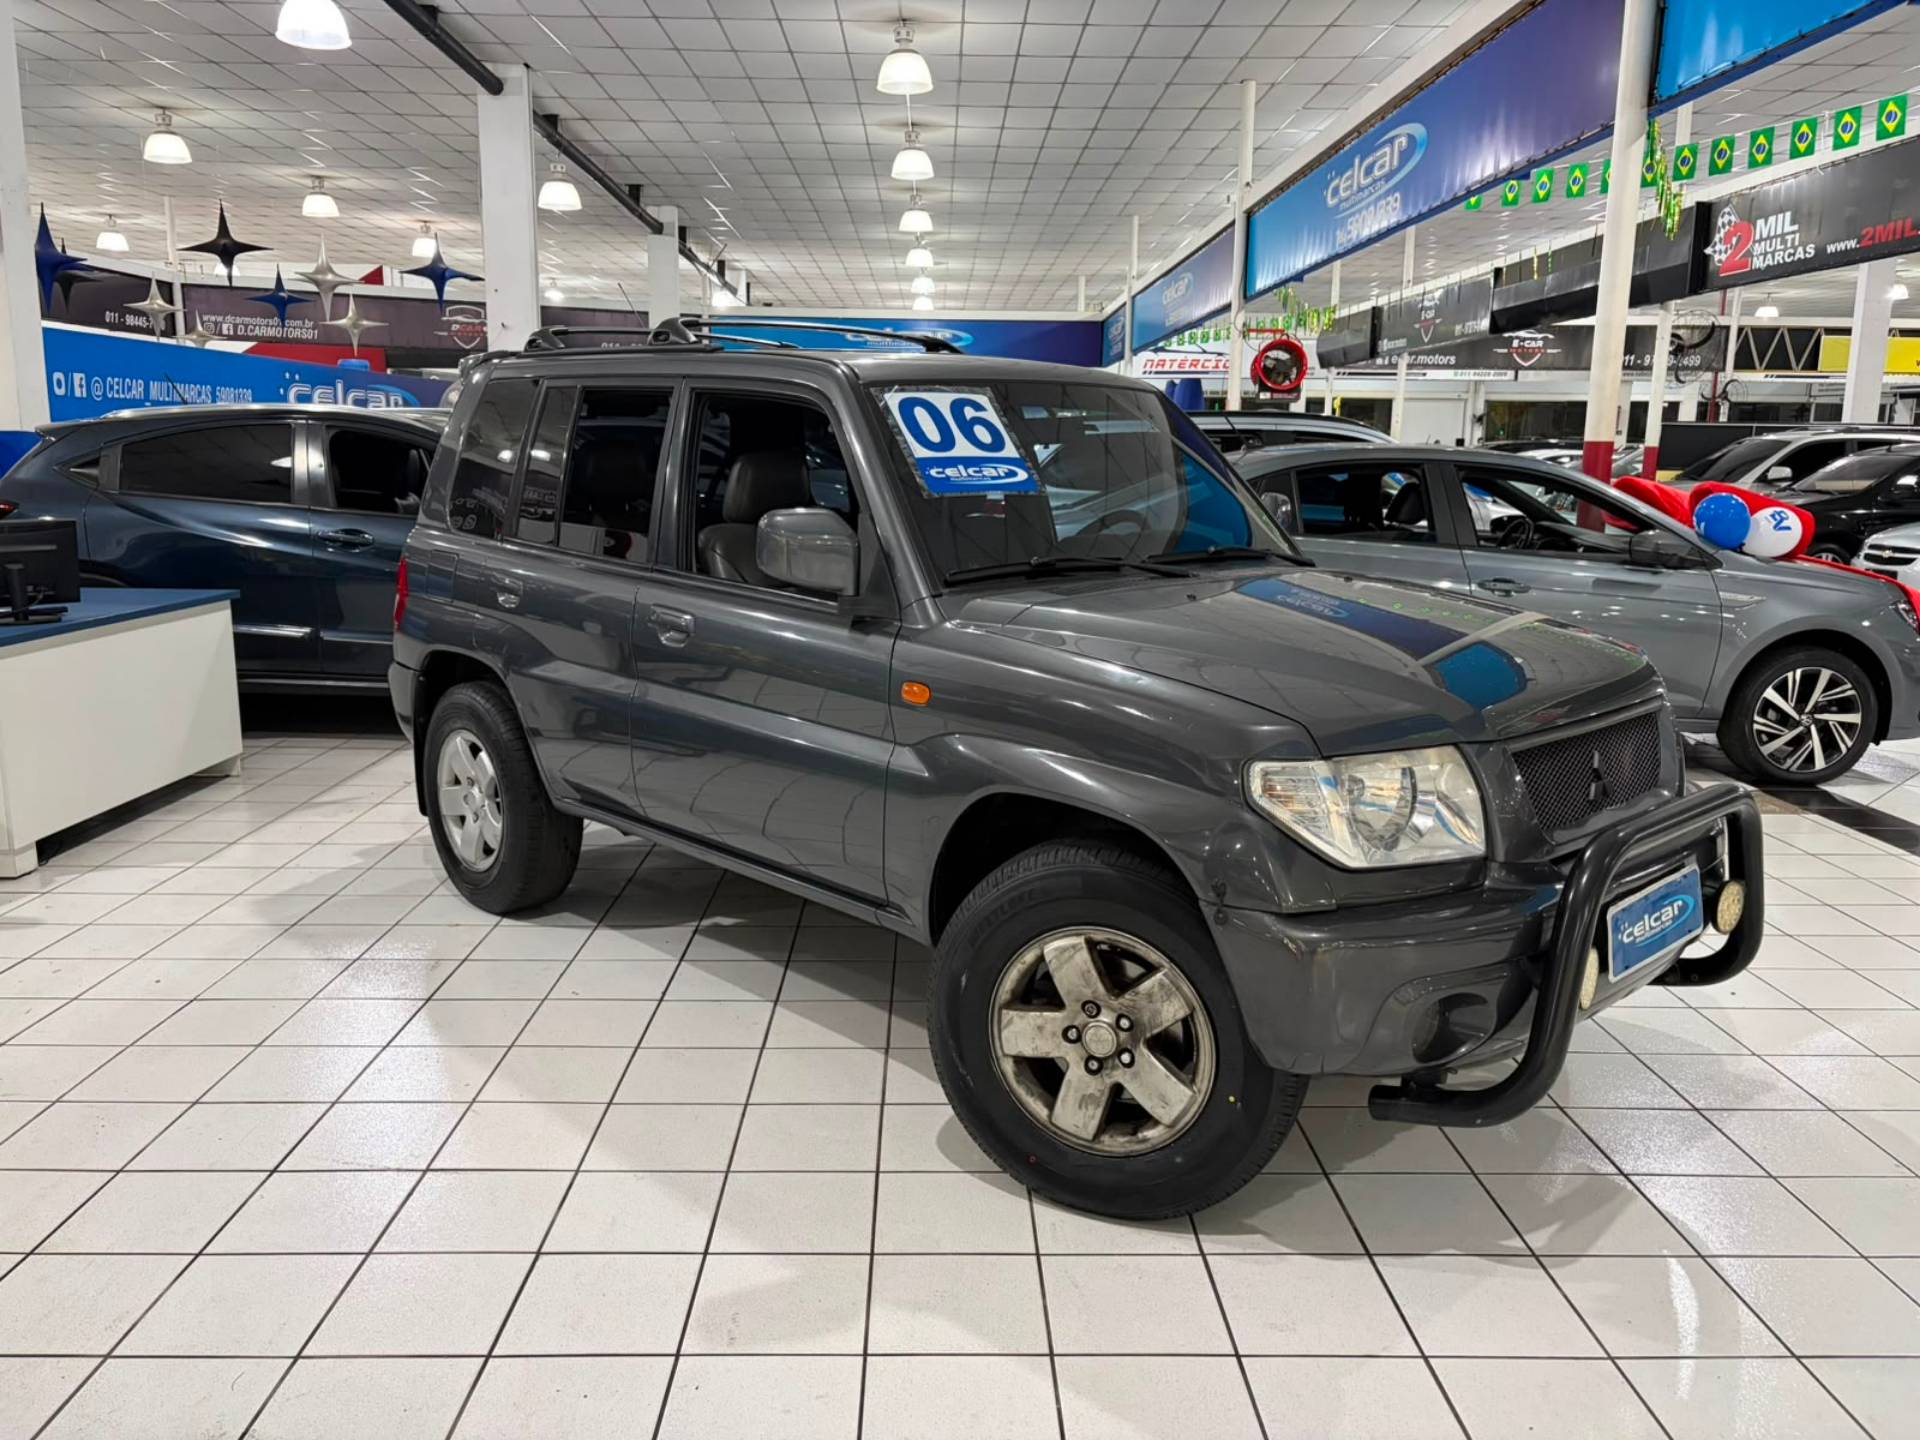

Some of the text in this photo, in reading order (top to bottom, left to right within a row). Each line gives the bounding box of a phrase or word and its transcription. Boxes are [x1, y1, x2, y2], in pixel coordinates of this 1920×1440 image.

[1326, 134, 1408, 208] celcar
[1719, 211, 1800, 276] 2 MIL
[1752, 232, 1800, 255] MULTI
[1752, 244, 1816, 270] MARCAS
[1512, 339, 1544, 348] E-CAR
[897, 396, 1006, 453] 06
[929, 464, 1010, 479] celcar
[1622, 900, 1684, 944] celcar
